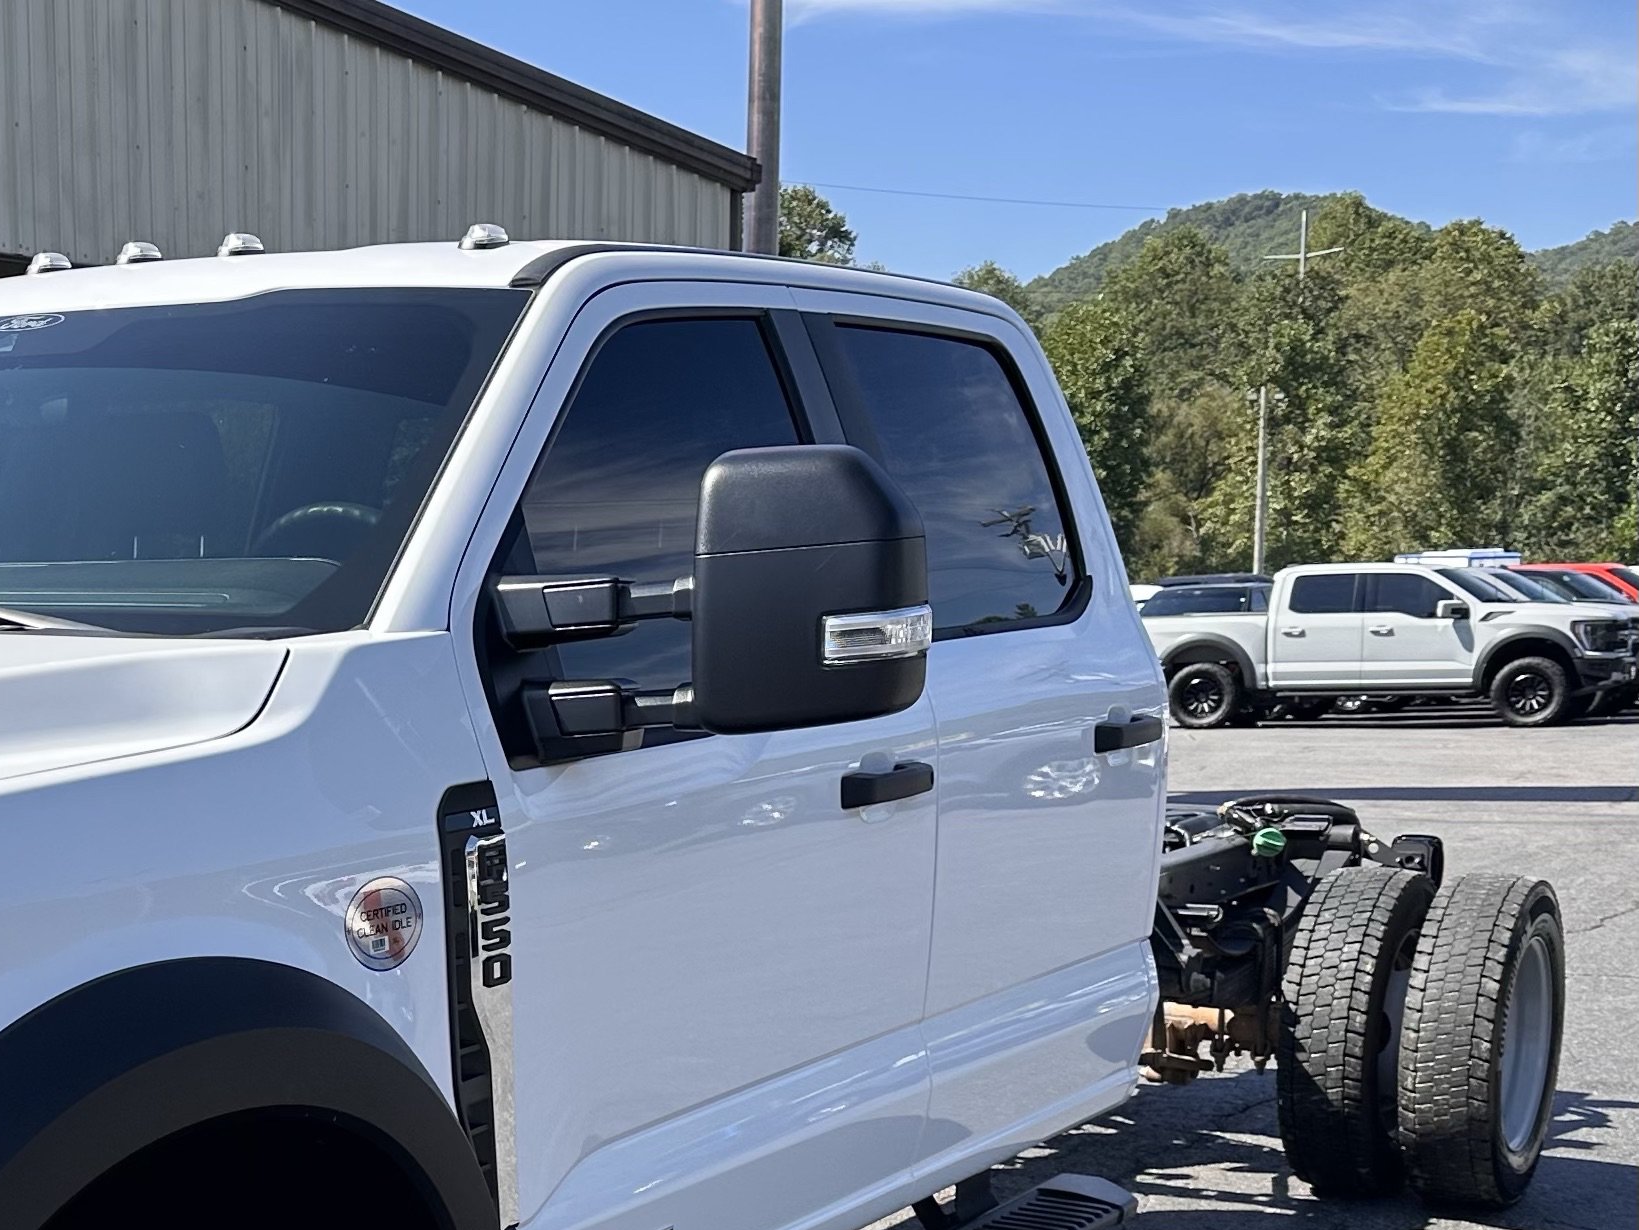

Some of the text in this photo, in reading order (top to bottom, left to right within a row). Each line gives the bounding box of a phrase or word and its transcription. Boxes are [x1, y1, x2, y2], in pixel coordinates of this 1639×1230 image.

[0, 315, 54, 330] Ford
[469, 808, 496, 828] XL
[360, 902, 408, 923] CERTIFIED
[356, 916, 413, 940] CLEAN IDLE
